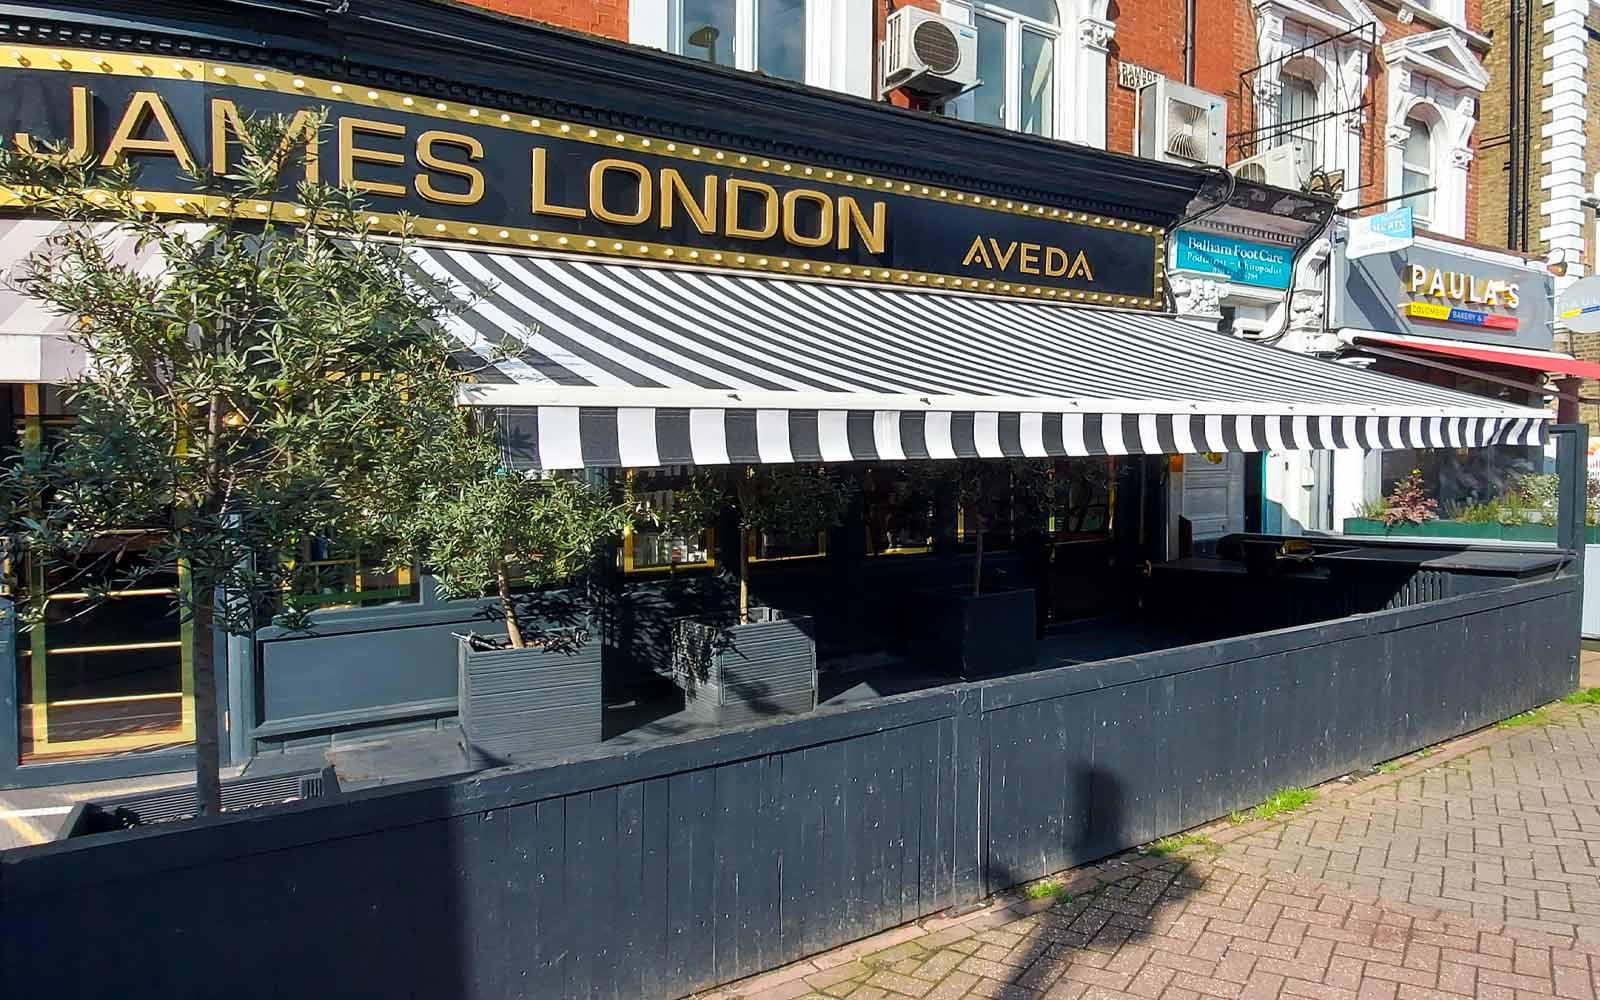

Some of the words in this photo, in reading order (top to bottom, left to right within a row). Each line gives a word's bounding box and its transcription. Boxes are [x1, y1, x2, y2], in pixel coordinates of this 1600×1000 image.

[15, 86, 485, 206] JAMES
[532, 147, 887, 255] LONDON
[962, 234, 1094, 281] AVEDA
[1188, 237, 1232, 256] Balham
[1234, 244, 1259, 260] Foot
[1259, 248, 1284, 264] Care
[1409, 263, 1520, 309] PAULA'S
